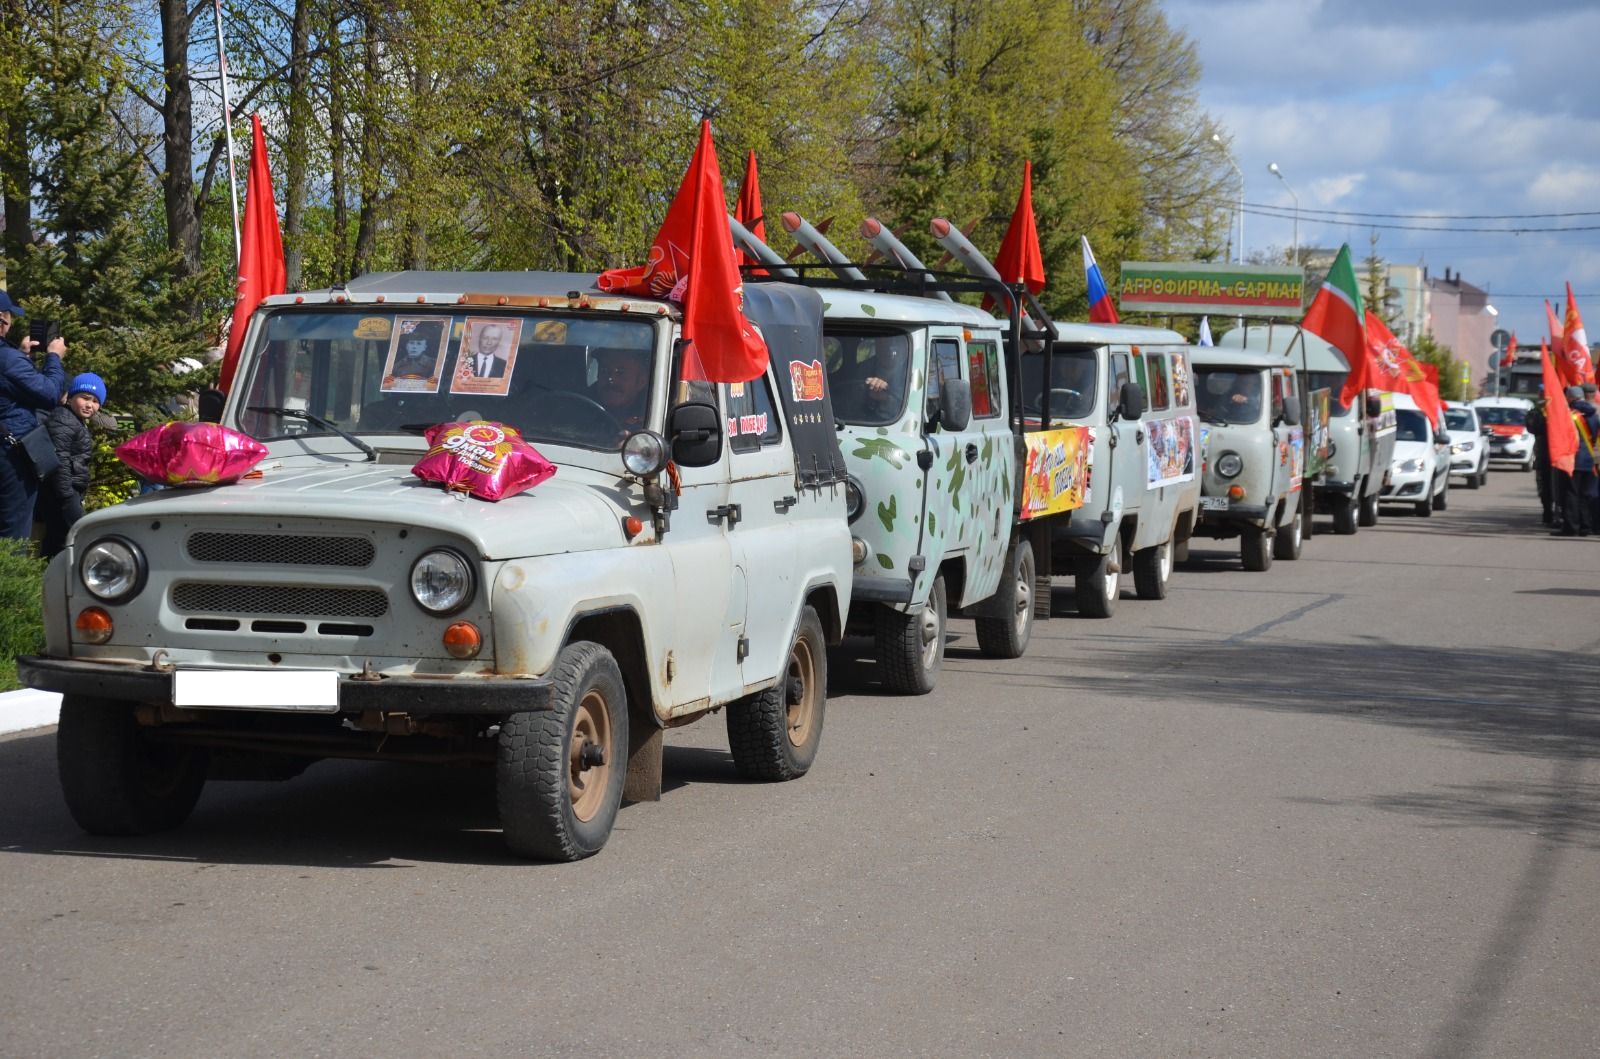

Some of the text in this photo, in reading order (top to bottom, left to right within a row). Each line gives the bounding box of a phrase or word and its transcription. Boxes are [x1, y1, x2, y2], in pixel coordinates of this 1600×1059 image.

[1122, 278, 1221, 297] АГРОФИРМА
[728, 418, 738, 437] ЗА
[442, 435, 466, 449] 9
